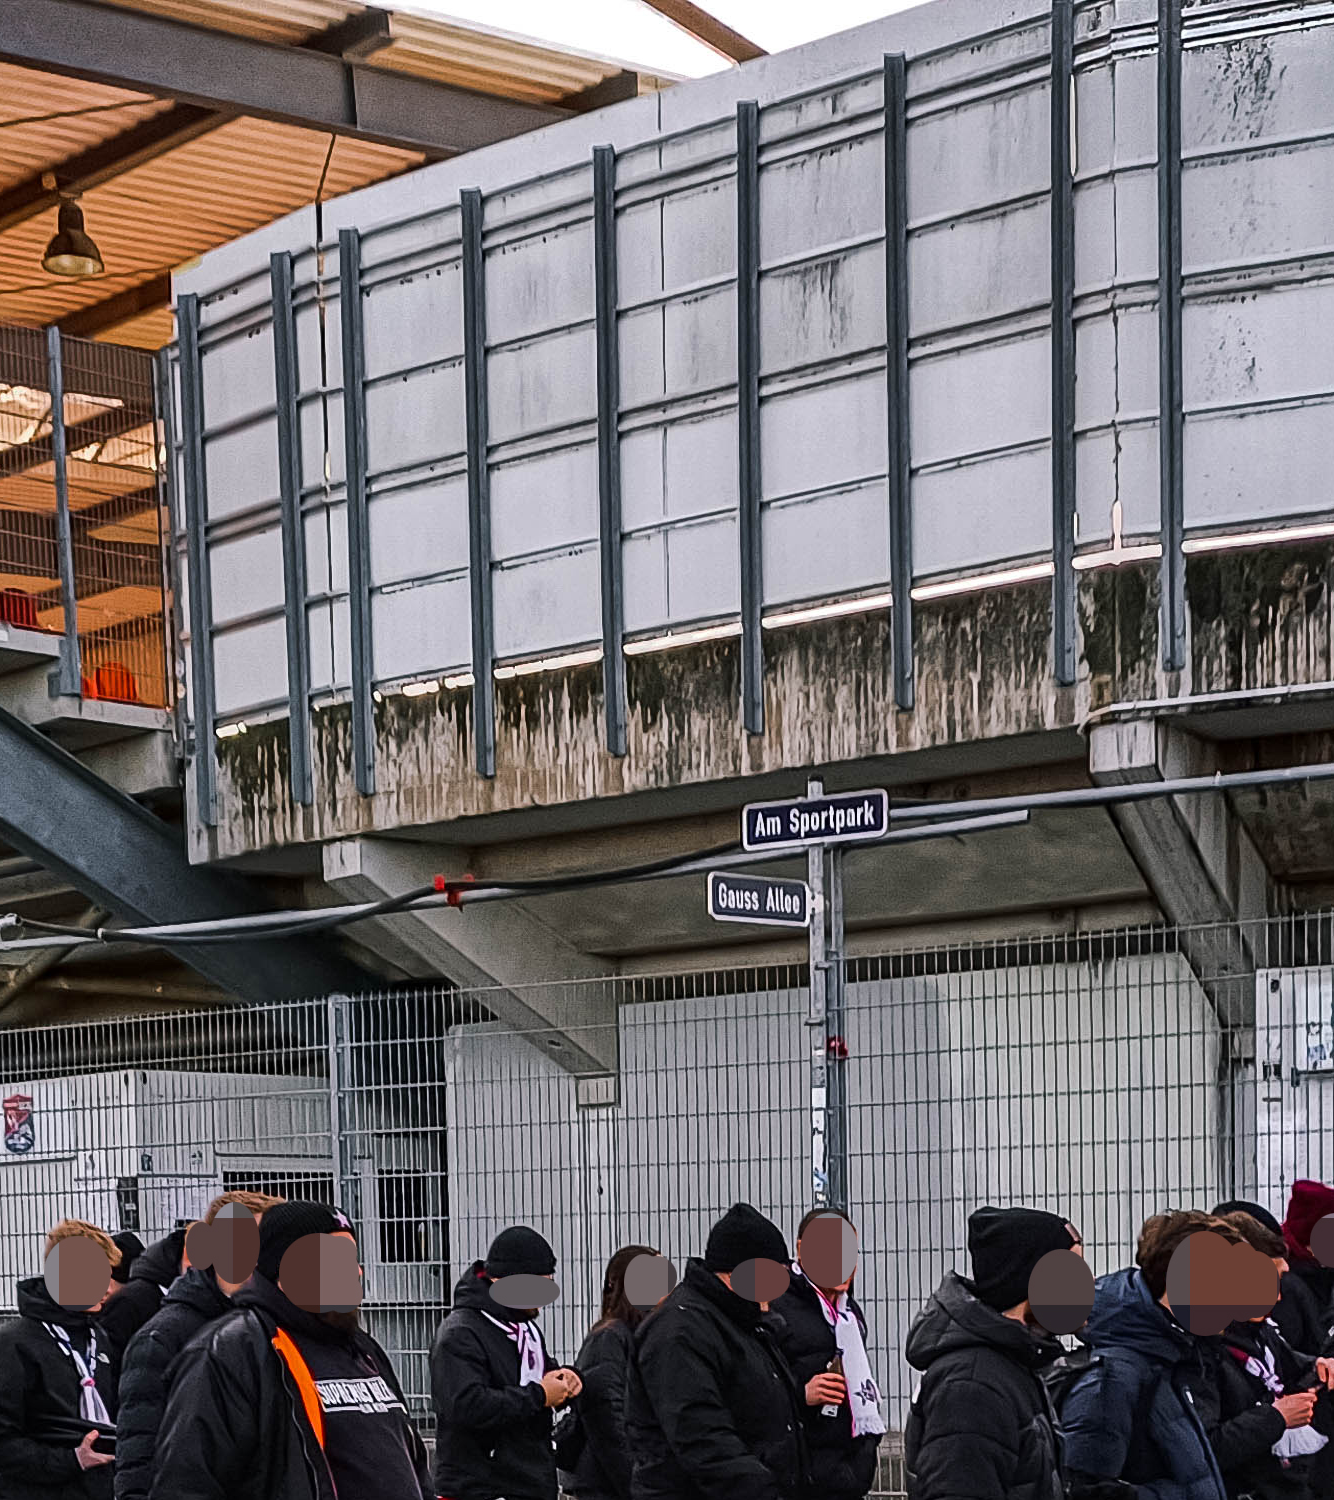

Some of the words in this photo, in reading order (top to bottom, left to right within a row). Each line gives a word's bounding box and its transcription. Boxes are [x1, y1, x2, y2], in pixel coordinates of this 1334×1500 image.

[754, 811, 782, 838] Am
[789, 799, 876, 838] Sportpark
[718, 882, 760, 911] Gauss
